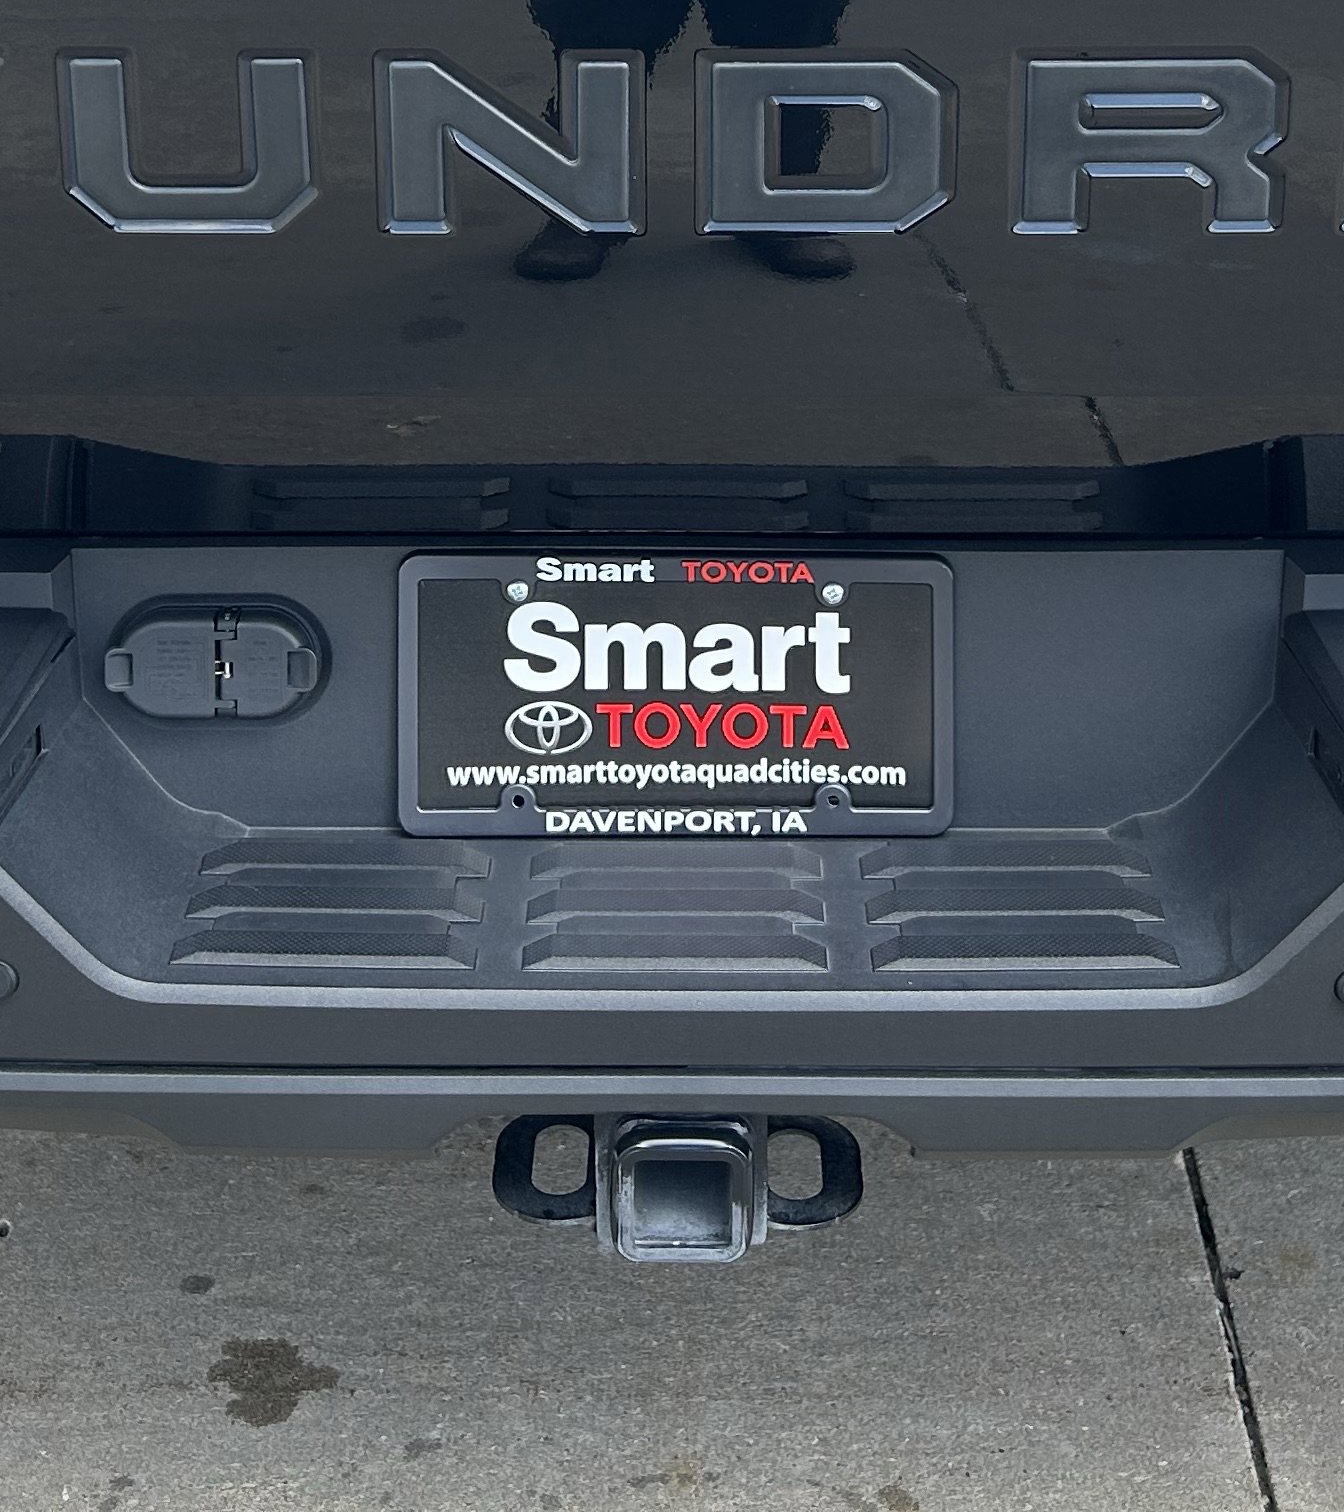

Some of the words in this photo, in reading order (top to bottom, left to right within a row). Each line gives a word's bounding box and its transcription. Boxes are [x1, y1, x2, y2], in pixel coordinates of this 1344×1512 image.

[535, 557, 655, 583] Smart
[681, 560, 815, 584] TOYOTA
[504, 601, 851, 694] Smart
[596, 702, 850, 749] TOYOTA
[447, 758, 906, 789] www.smarttoyotaquadcities.com
[545, 809, 762, 835] DAVENPORT,
[771, 810, 807, 833] IA
